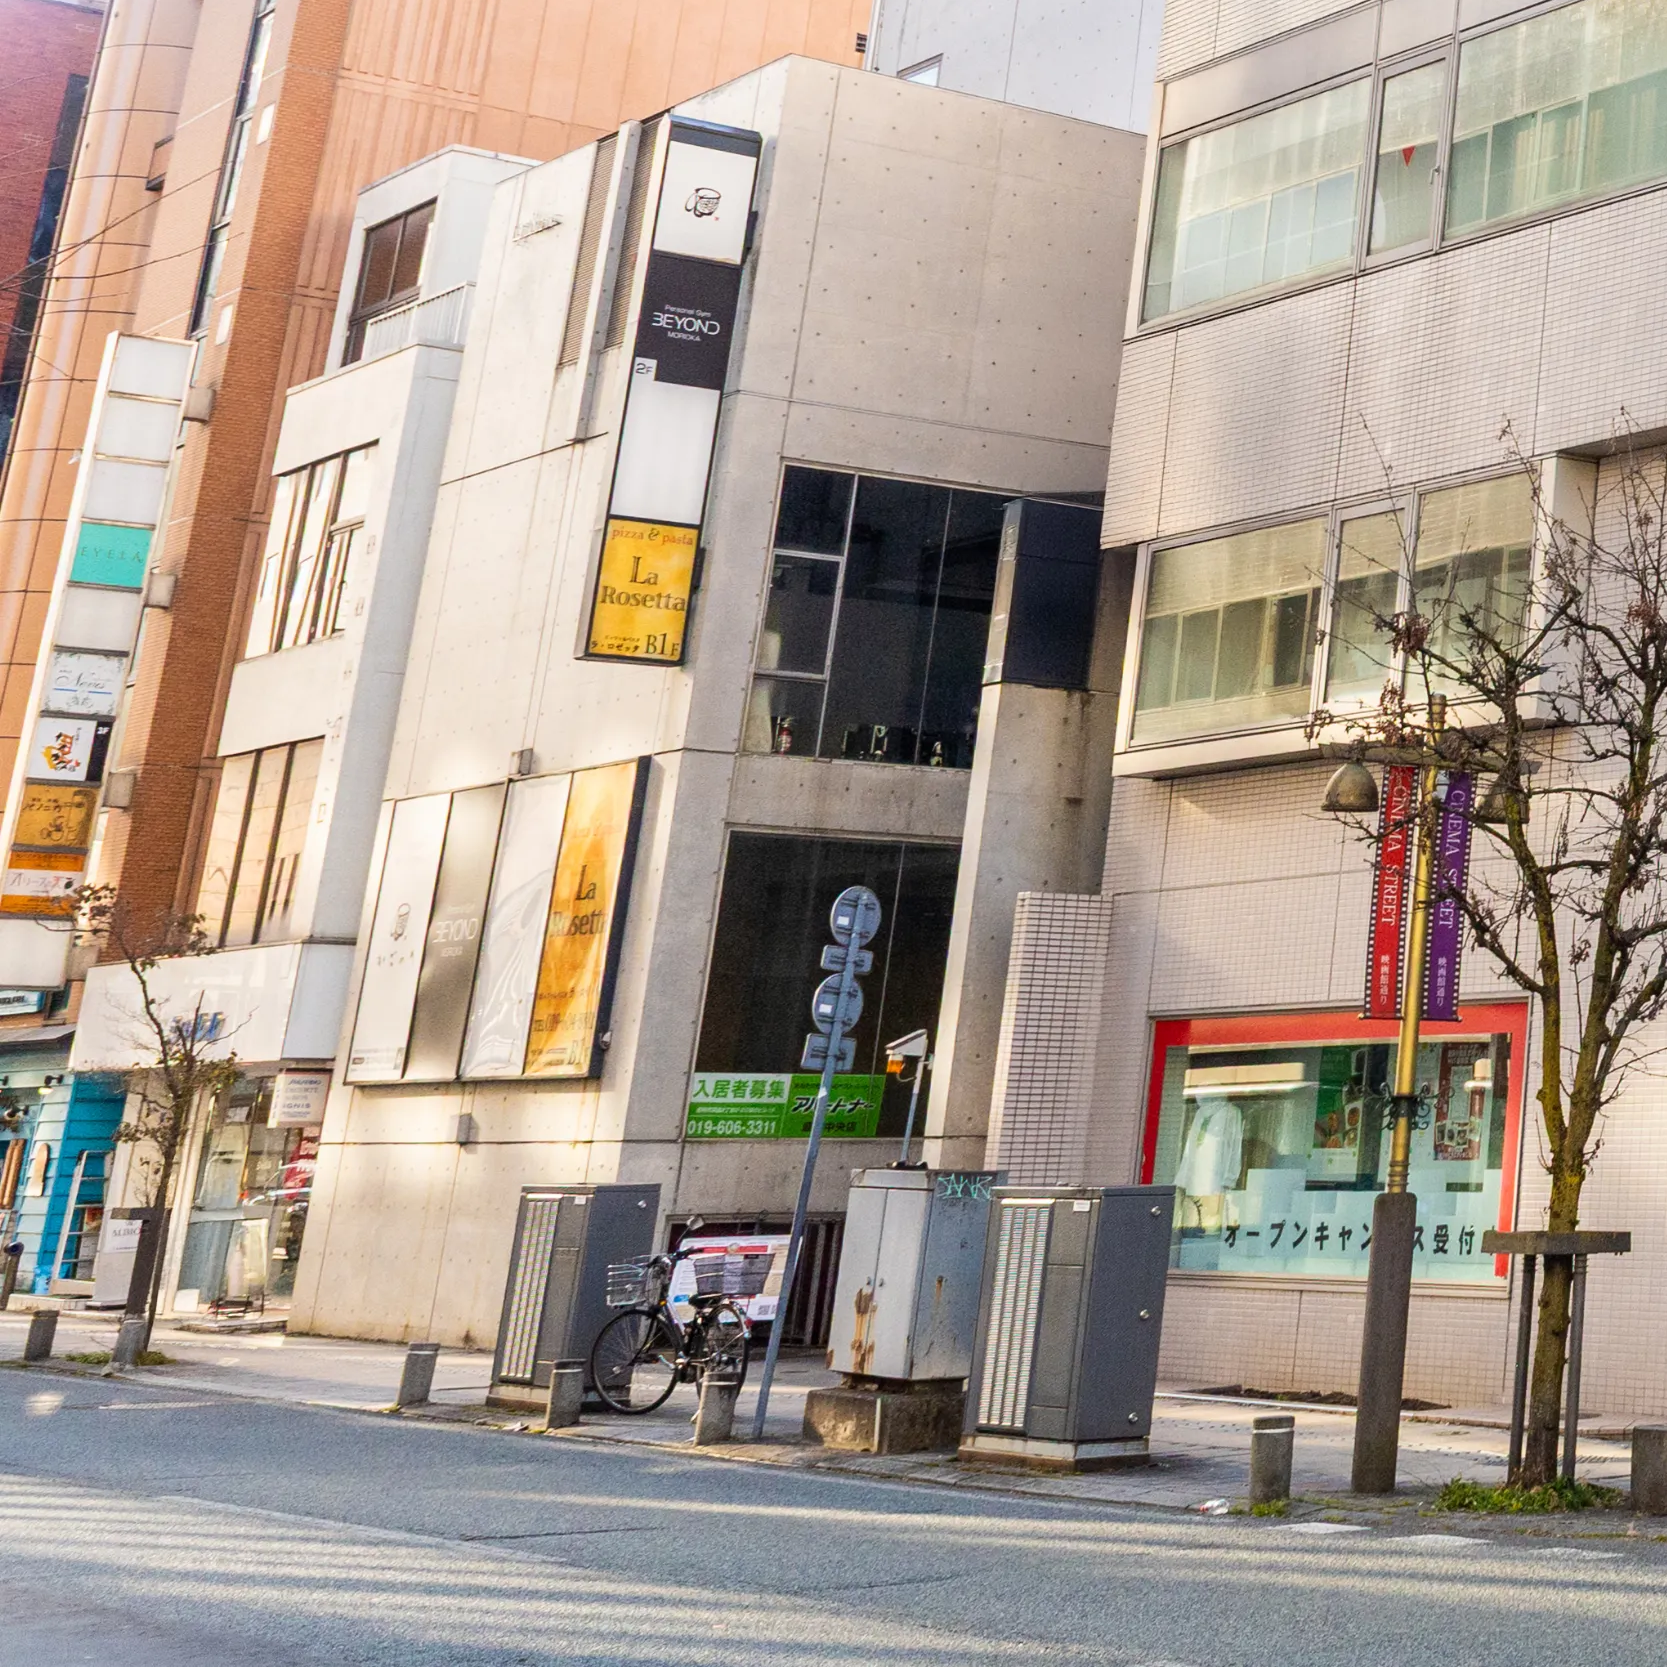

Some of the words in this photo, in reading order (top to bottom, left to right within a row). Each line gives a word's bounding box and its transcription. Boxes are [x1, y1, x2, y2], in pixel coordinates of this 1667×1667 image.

[651, 312, 720, 335] BEYOND
[635, 363, 653, 375] 2F
[611, 526, 645, 540] pizza
[662, 533, 694, 546] pasta
[629, 555, 659, 586] La
[599, 585, 686, 612] Rosetta
[574, 864, 597, 901] La
[1381, 863, 1400, 927] STREET
[1378, 953, 1392, 1007] 映画館通り
[1435, 955, 1448, 1008] 映画館通り
[692, 1079, 786, 1100] 入居者募集
[687, 1119, 777, 1135] 019-606-3311
[1224, 1218, 1477, 1256] オープンキャンス受付
